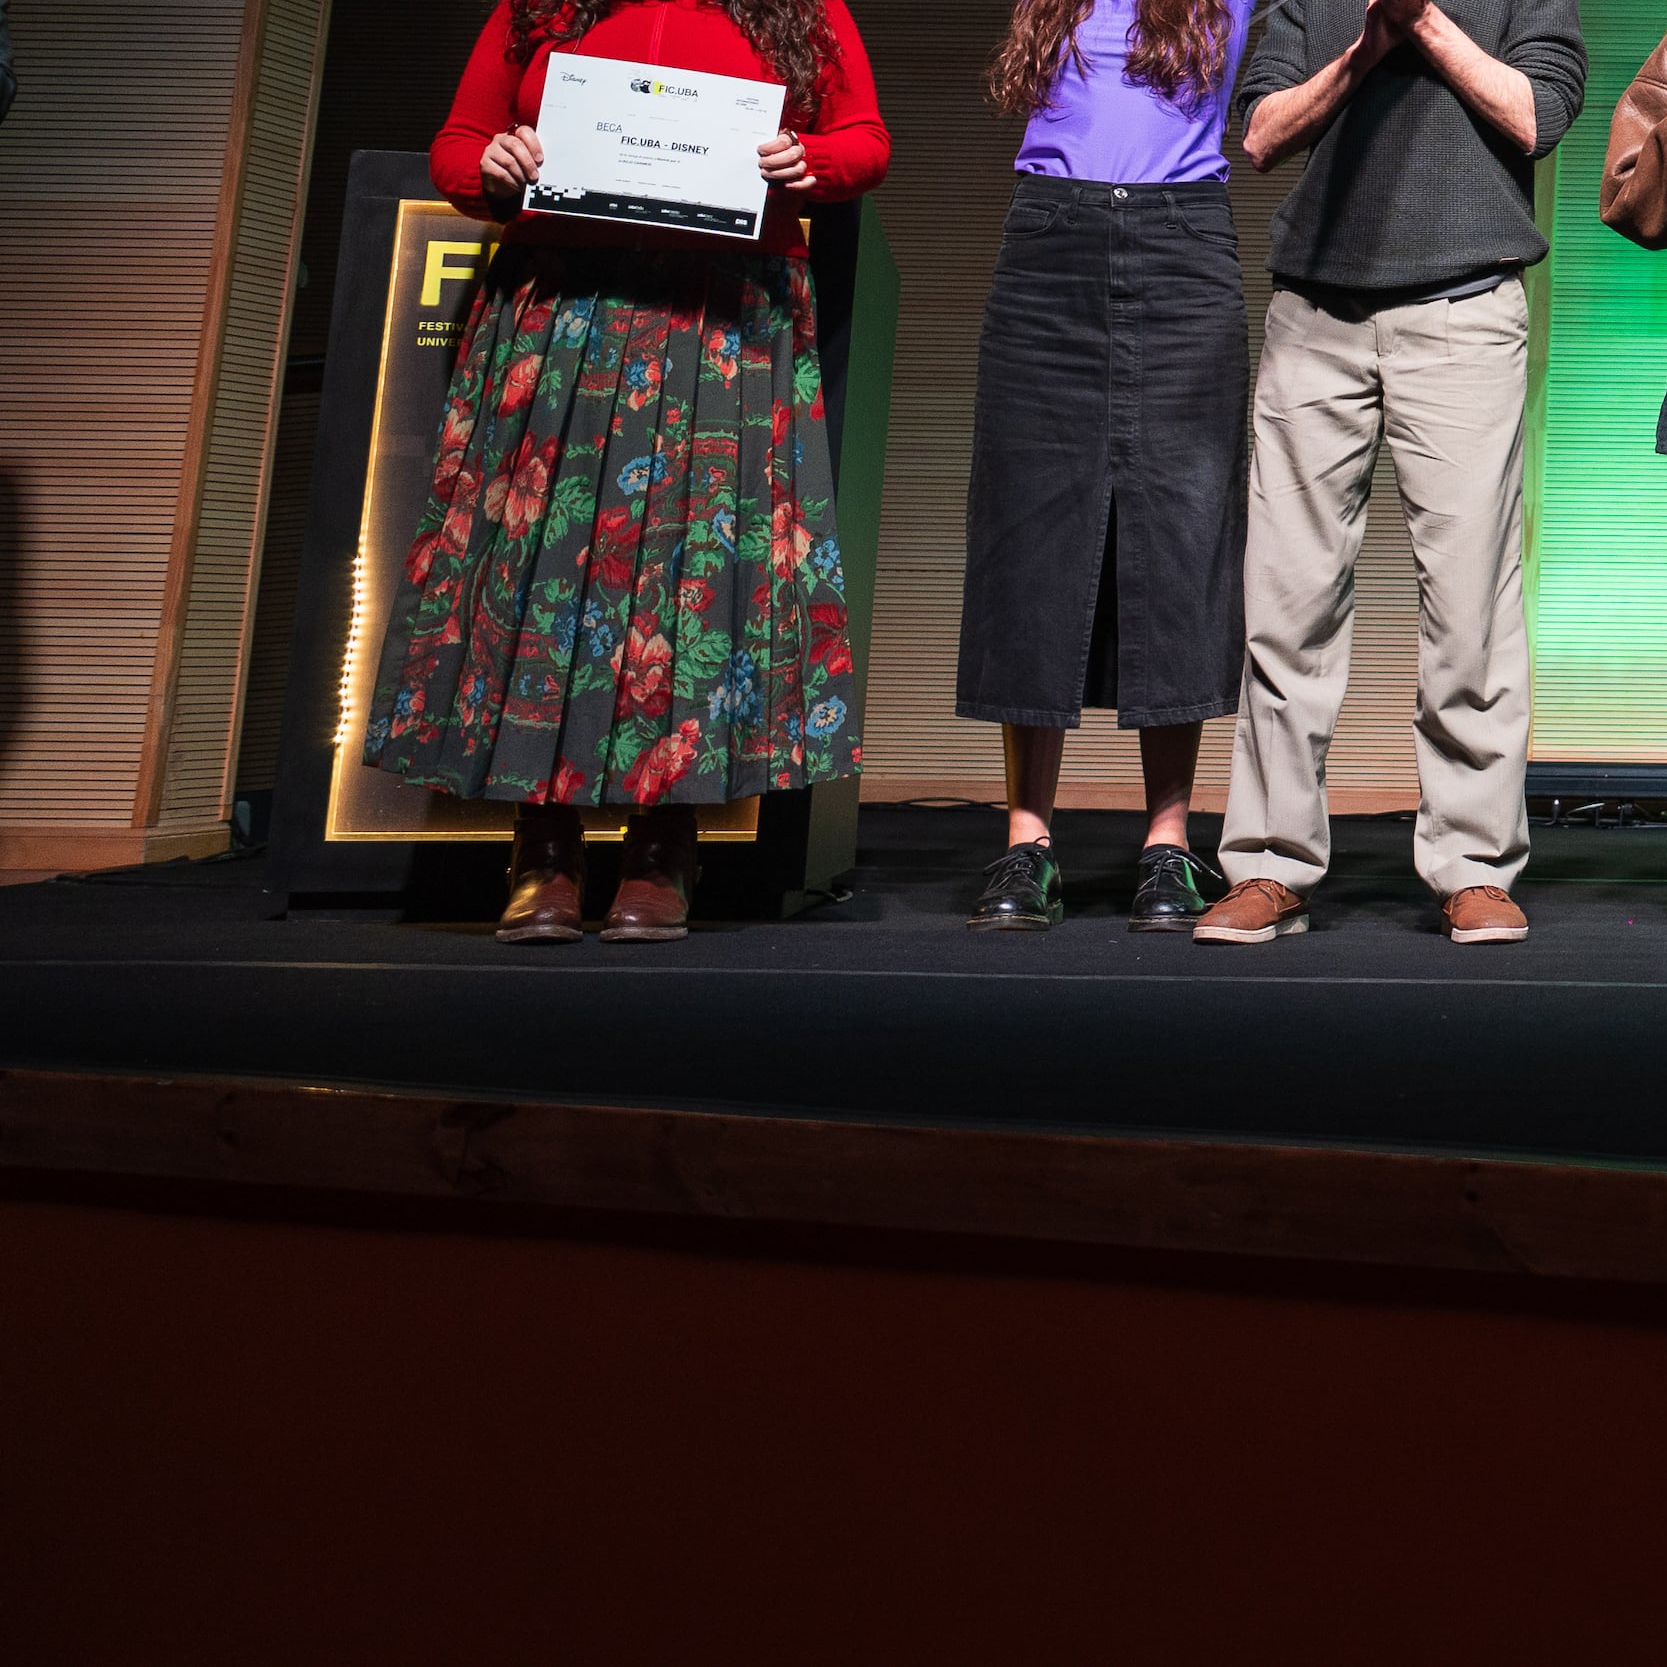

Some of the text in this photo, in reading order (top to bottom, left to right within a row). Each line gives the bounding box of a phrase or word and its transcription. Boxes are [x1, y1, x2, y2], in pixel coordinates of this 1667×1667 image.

[658, 84, 699, 98] FIC.UBA
[596, 121, 623, 134] BECA
[620, 135, 661, 149] FIC.UBA
[671, 142, 709, 155] DISNEY
[421, 240, 500, 306] F
[418, 321, 465, 331] FESTIV
